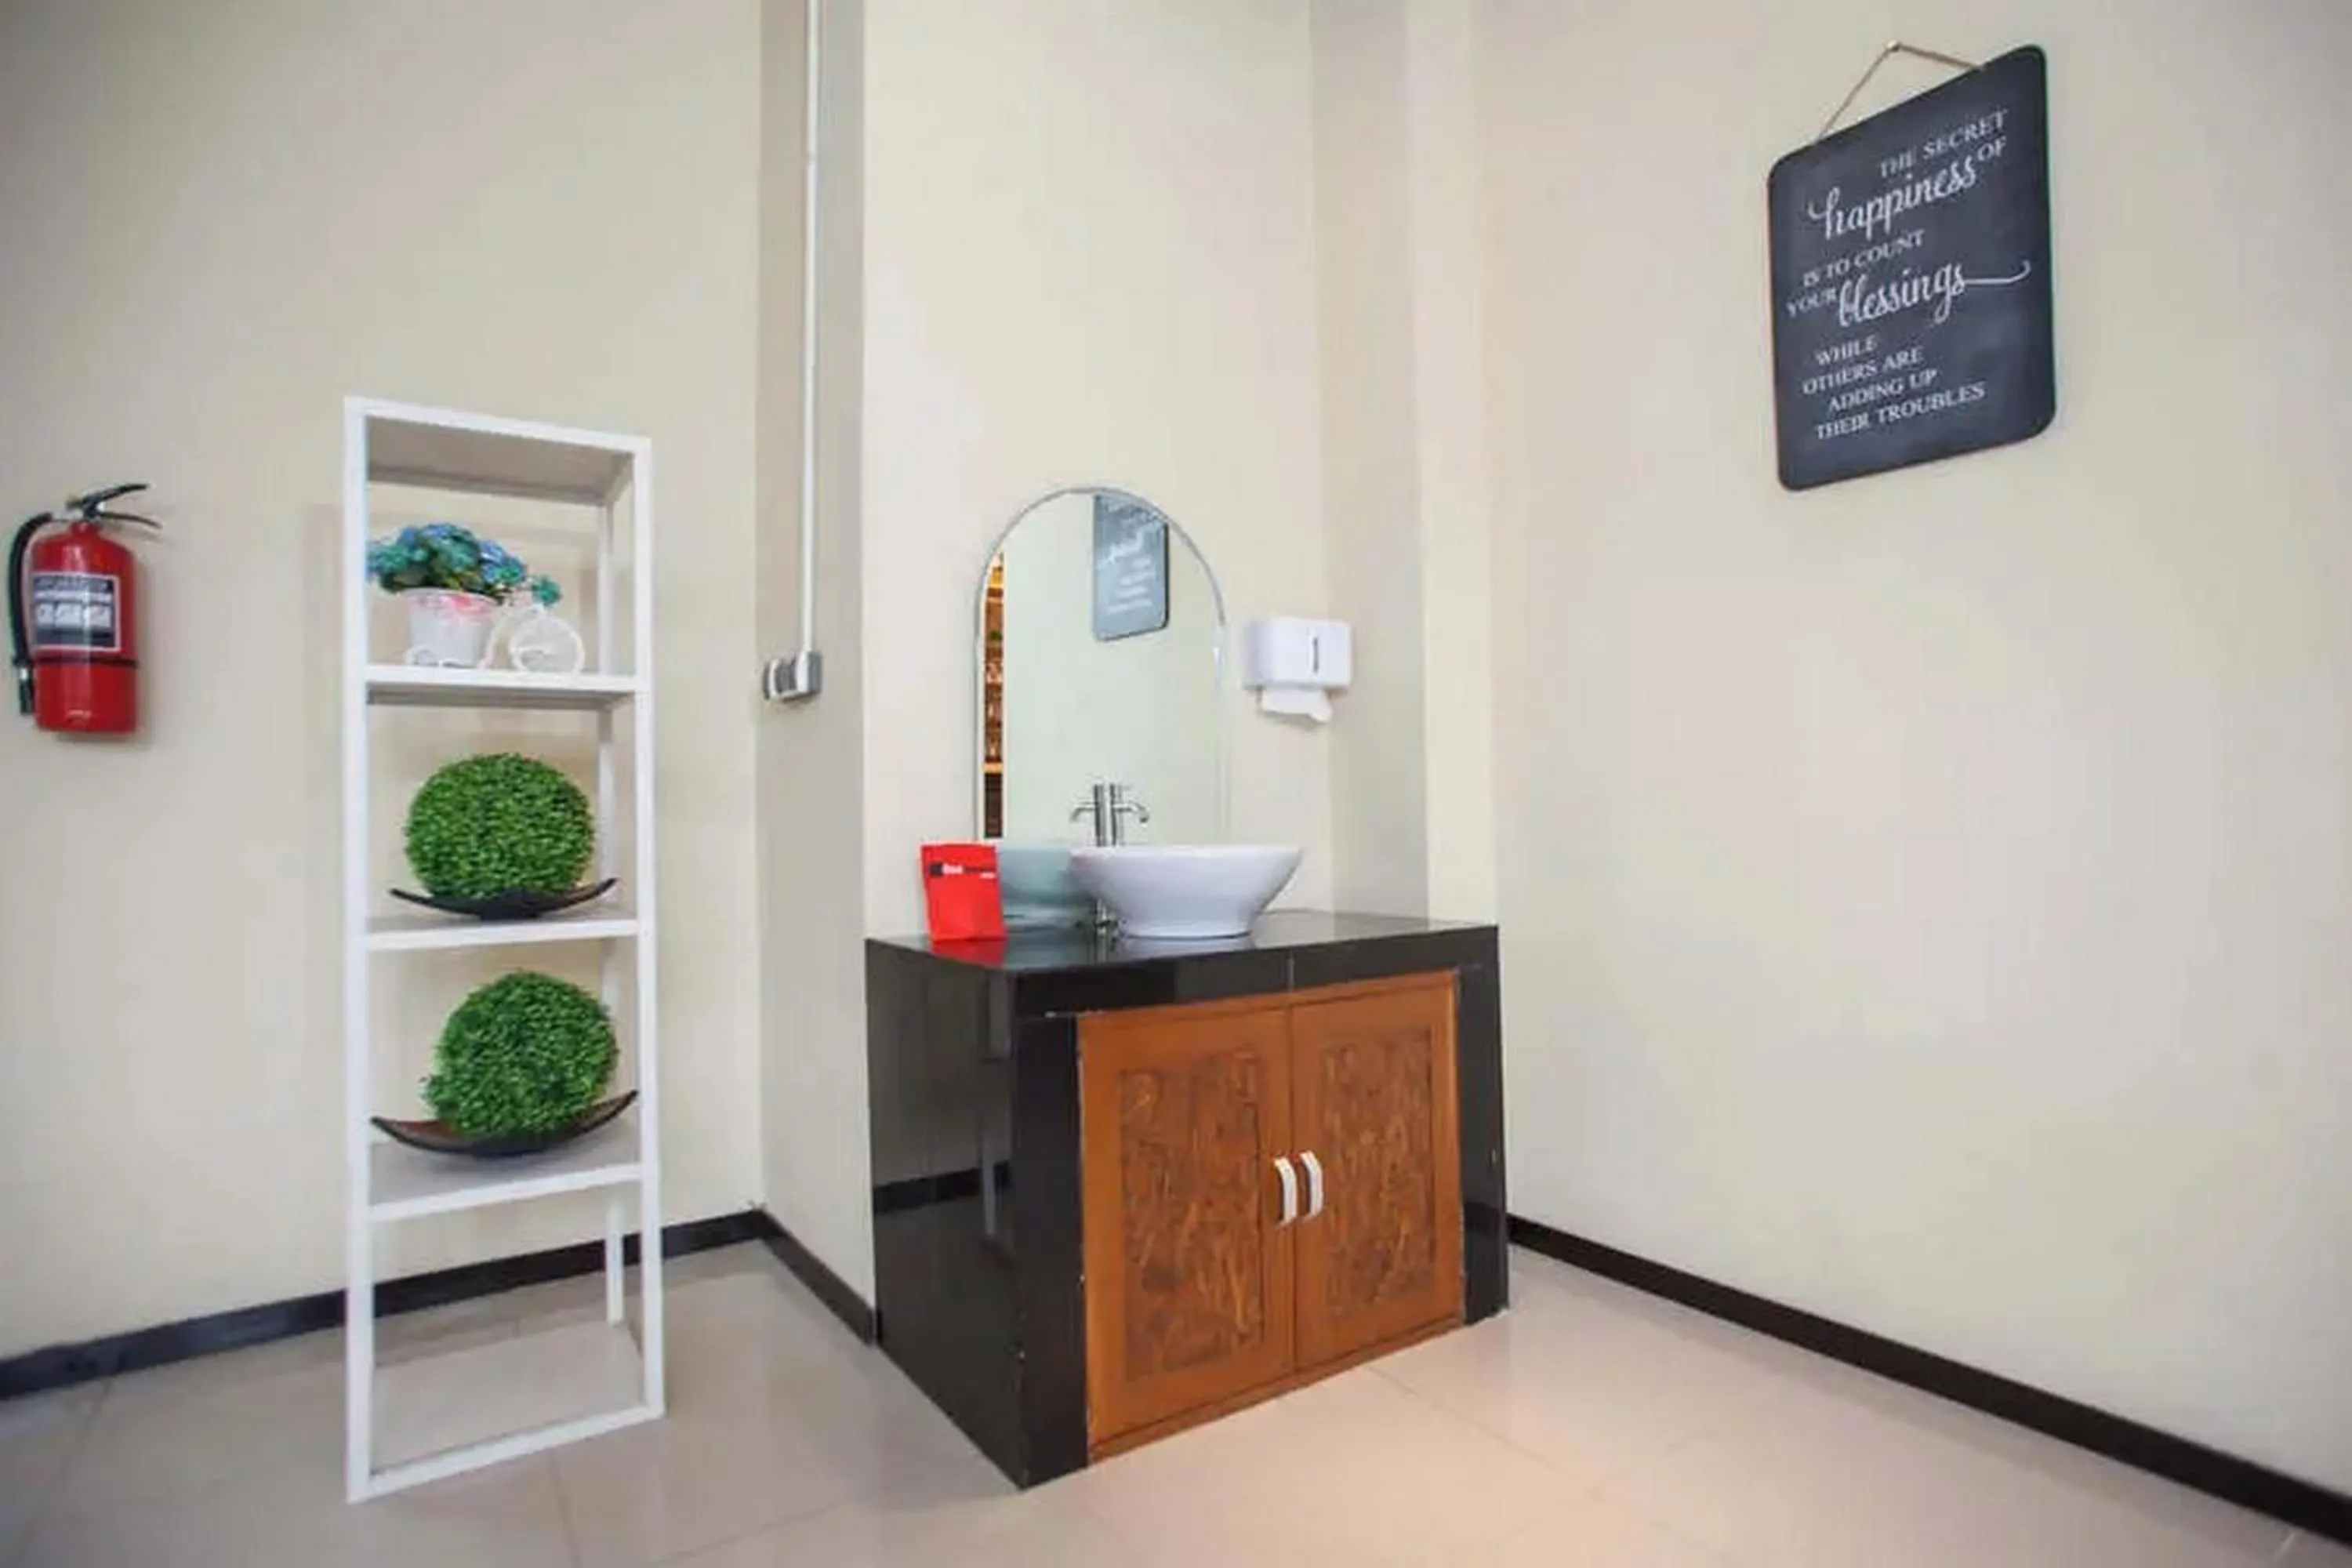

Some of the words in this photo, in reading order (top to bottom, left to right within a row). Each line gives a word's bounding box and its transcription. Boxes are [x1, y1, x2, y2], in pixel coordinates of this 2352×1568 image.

[1880, 145, 1918, 179] THE
[1922, 108, 2009, 160] SECRET
[1808, 155, 1976, 240] happiness
[1977, 136, 2007, 162] OF
[1803, 272, 1820, 288] IS
[1826, 260, 1851, 277] TO
[1854, 230, 1925, 267] COUNT
[1786, 286, 1838, 318] YOUR
[1838, 260, 2032, 327] blessings
[1802, 360, 1878, 394] OTHERS
[1882, 345, 1924, 373] ARE
[1815, 334, 1878, 365] WHILE
[1816, 412, 1871, 440] THEIR
[1878, 381, 1987, 424] TROUBLES
[1828, 377, 1905, 412] ADDING
[1908, 368, 1938, 391] UP
